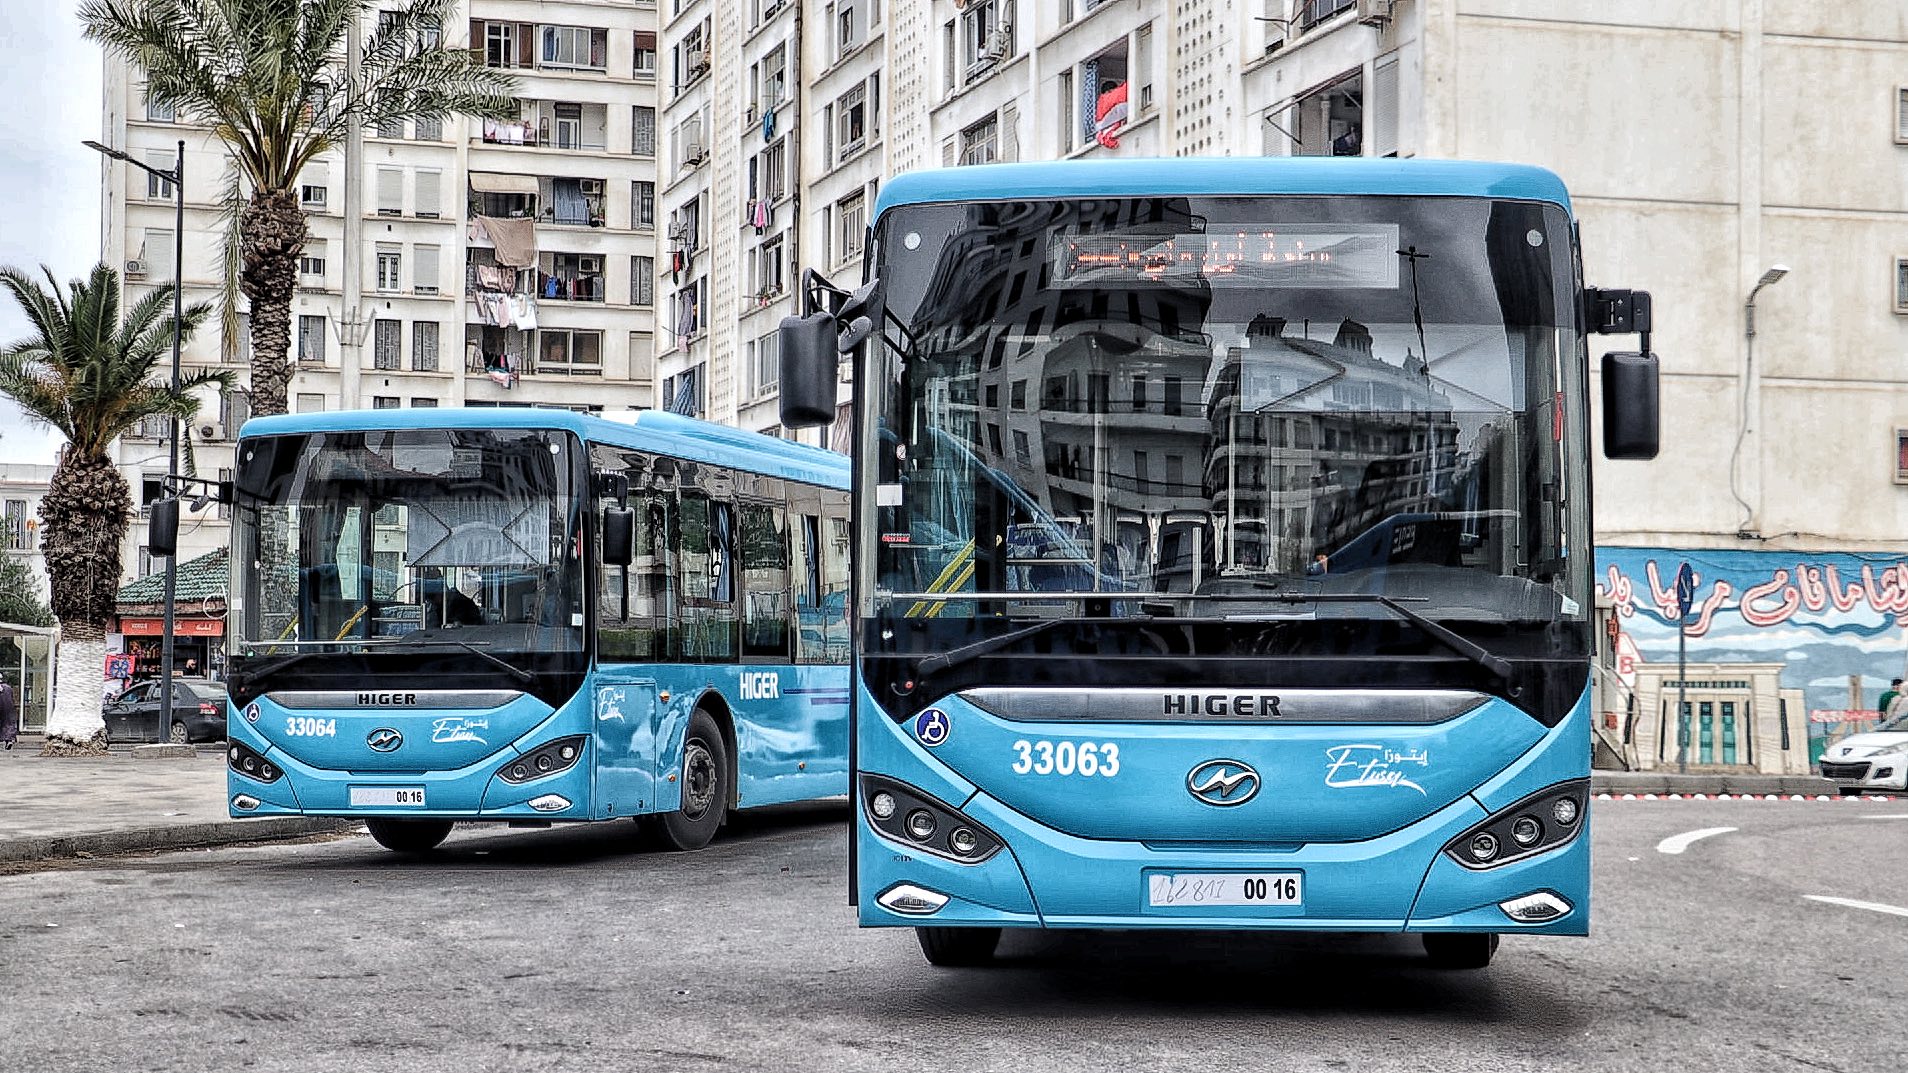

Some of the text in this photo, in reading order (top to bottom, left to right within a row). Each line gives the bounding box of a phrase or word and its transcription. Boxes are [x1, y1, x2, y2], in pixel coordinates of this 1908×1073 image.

[738, 672, 779, 699] HIGER
[358, 693, 416, 705] HIGER
[1163, 695, 1282, 716] HIGER
[285, 717, 336, 737] 33064
[1012, 740, 1120, 777] 33063
[396, 791, 408, 803] 00
[1243, 878, 1296, 900] 00 16
